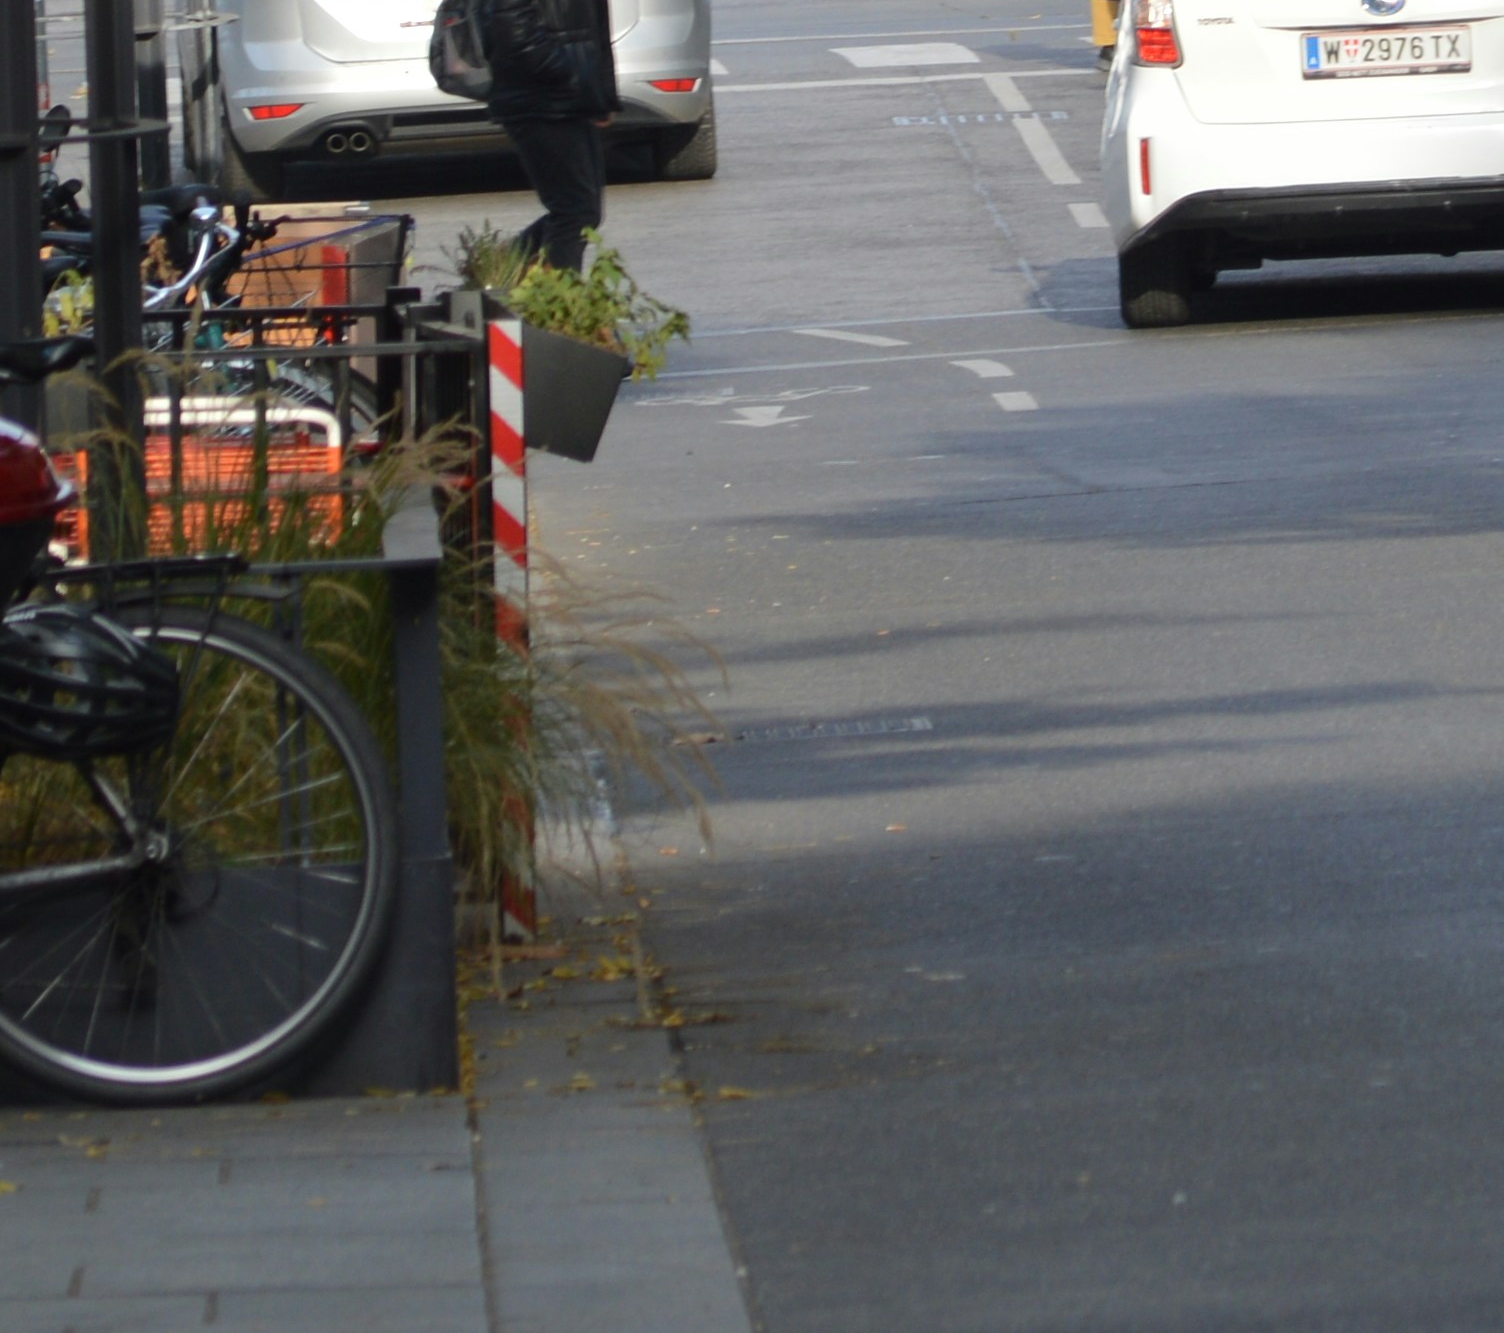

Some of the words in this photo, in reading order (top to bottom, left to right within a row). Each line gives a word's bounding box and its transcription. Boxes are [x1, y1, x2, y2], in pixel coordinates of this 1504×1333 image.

[1324, 40, 1341, 64] W
[1362, 36, 1424, 62] 2976
[1430, 34, 1461, 59] TX
